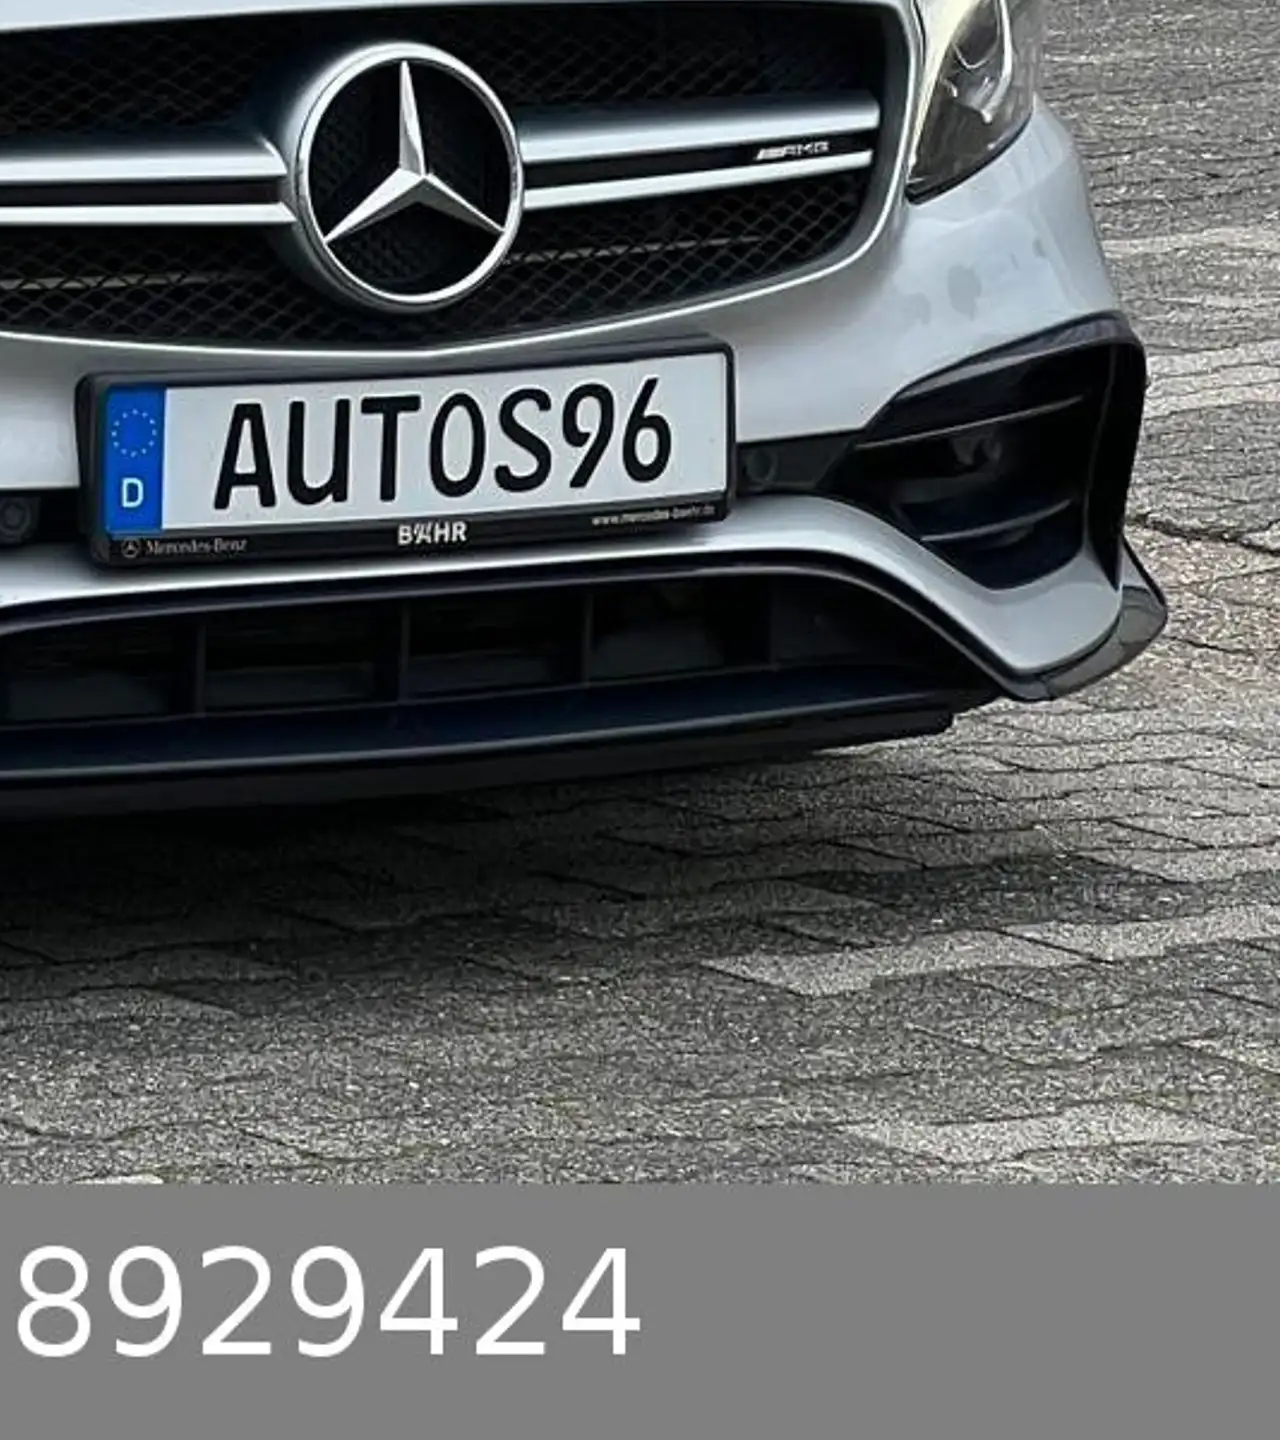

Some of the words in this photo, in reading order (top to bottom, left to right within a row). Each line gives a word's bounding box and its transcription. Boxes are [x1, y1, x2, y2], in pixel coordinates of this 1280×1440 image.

[213, 376, 671, 510] AUTOS96
[121, 477, 144, 510] D
[146, 538, 248, 556] Mercedes-Benz
